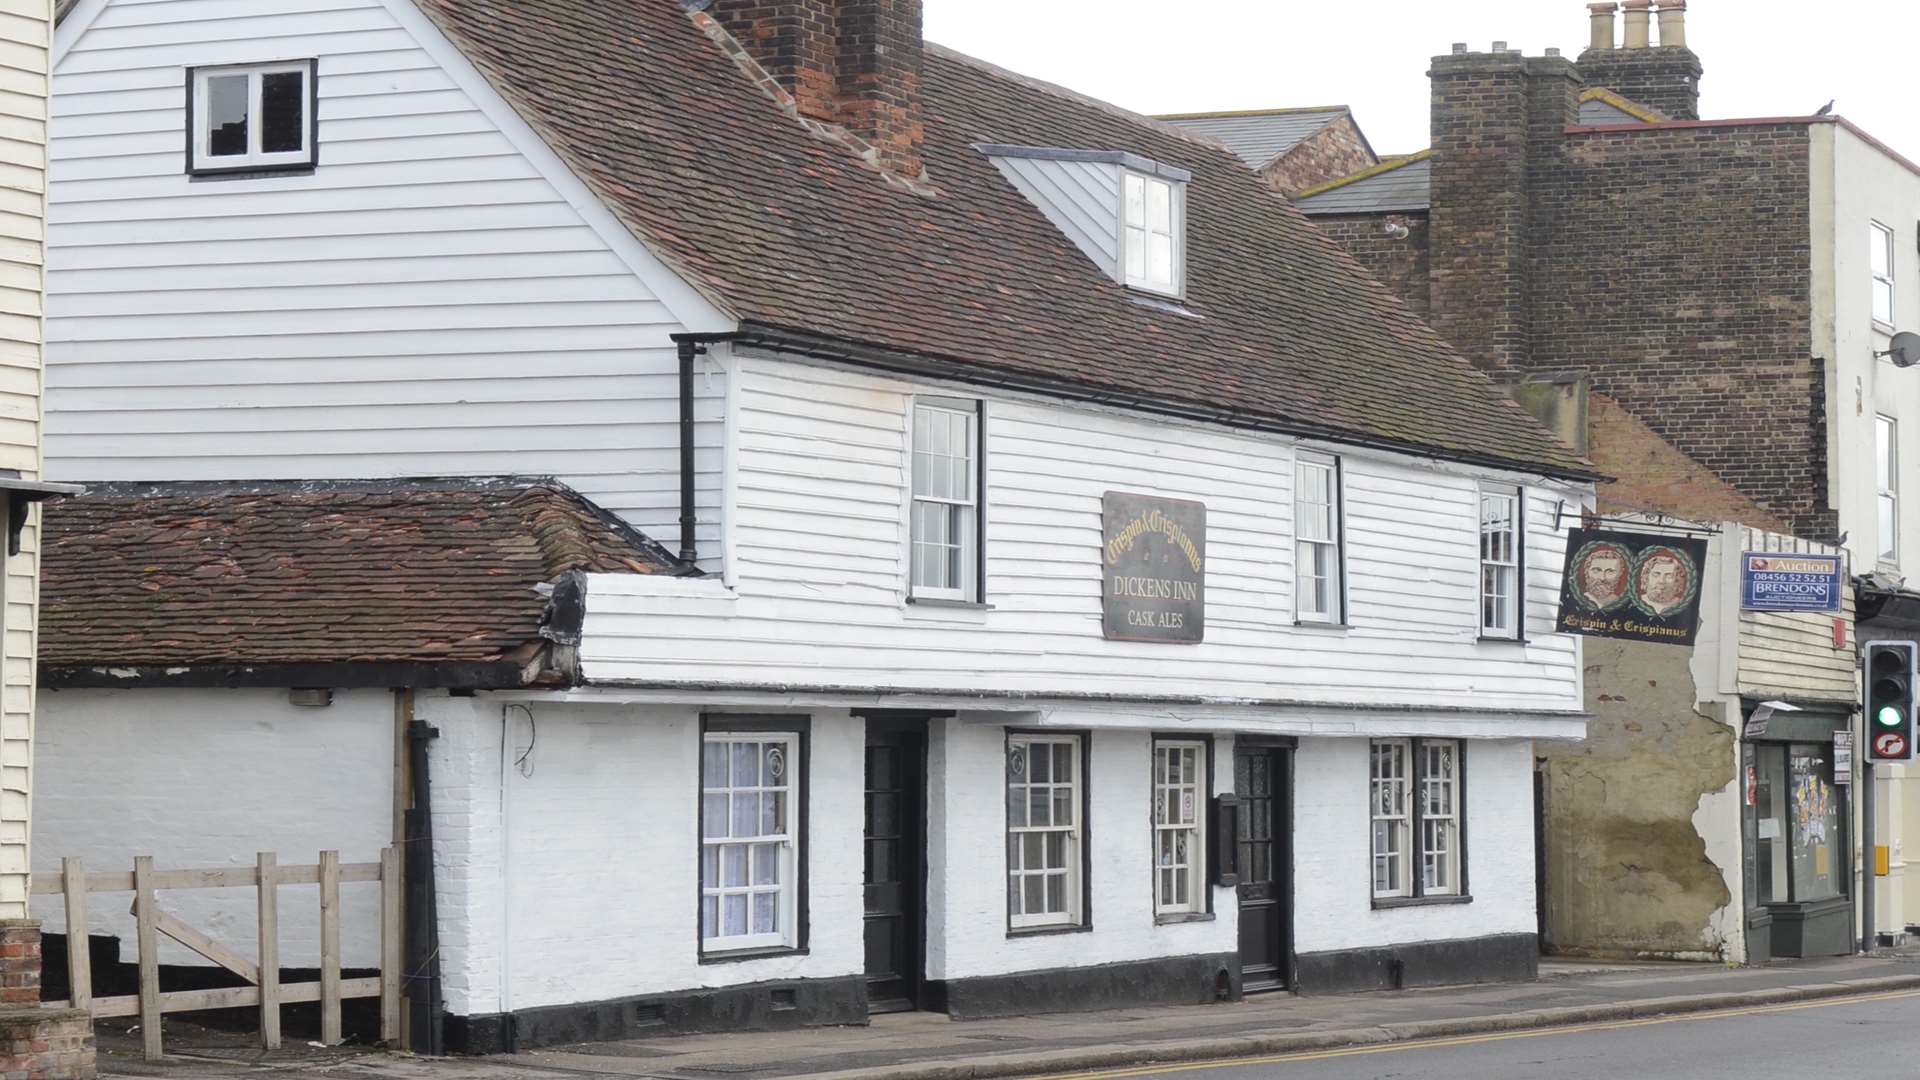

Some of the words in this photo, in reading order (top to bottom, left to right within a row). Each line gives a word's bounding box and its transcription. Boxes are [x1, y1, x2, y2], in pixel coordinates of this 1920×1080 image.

[1775, 560, 1829, 572] Auction
[1754, 573, 1786, 581] 08456
[1789, 574, 1802, 582] 52
[1803, 574, 1816, 582] 52
[1818, 575, 1830, 583] 51
[1114, 576, 1171, 599] DICKENS
[1174, 582, 1197, 600] INN
[1756, 583, 1826, 595] BRENDONS
[1128, 610, 1155, 627] CASK
[1158, 613, 1183, 628] ALES
[1563, 614, 1606, 630] Crispin
[1610, 619, 1623, 631] &
[1624, 620, 1687, 638] Crispianus
